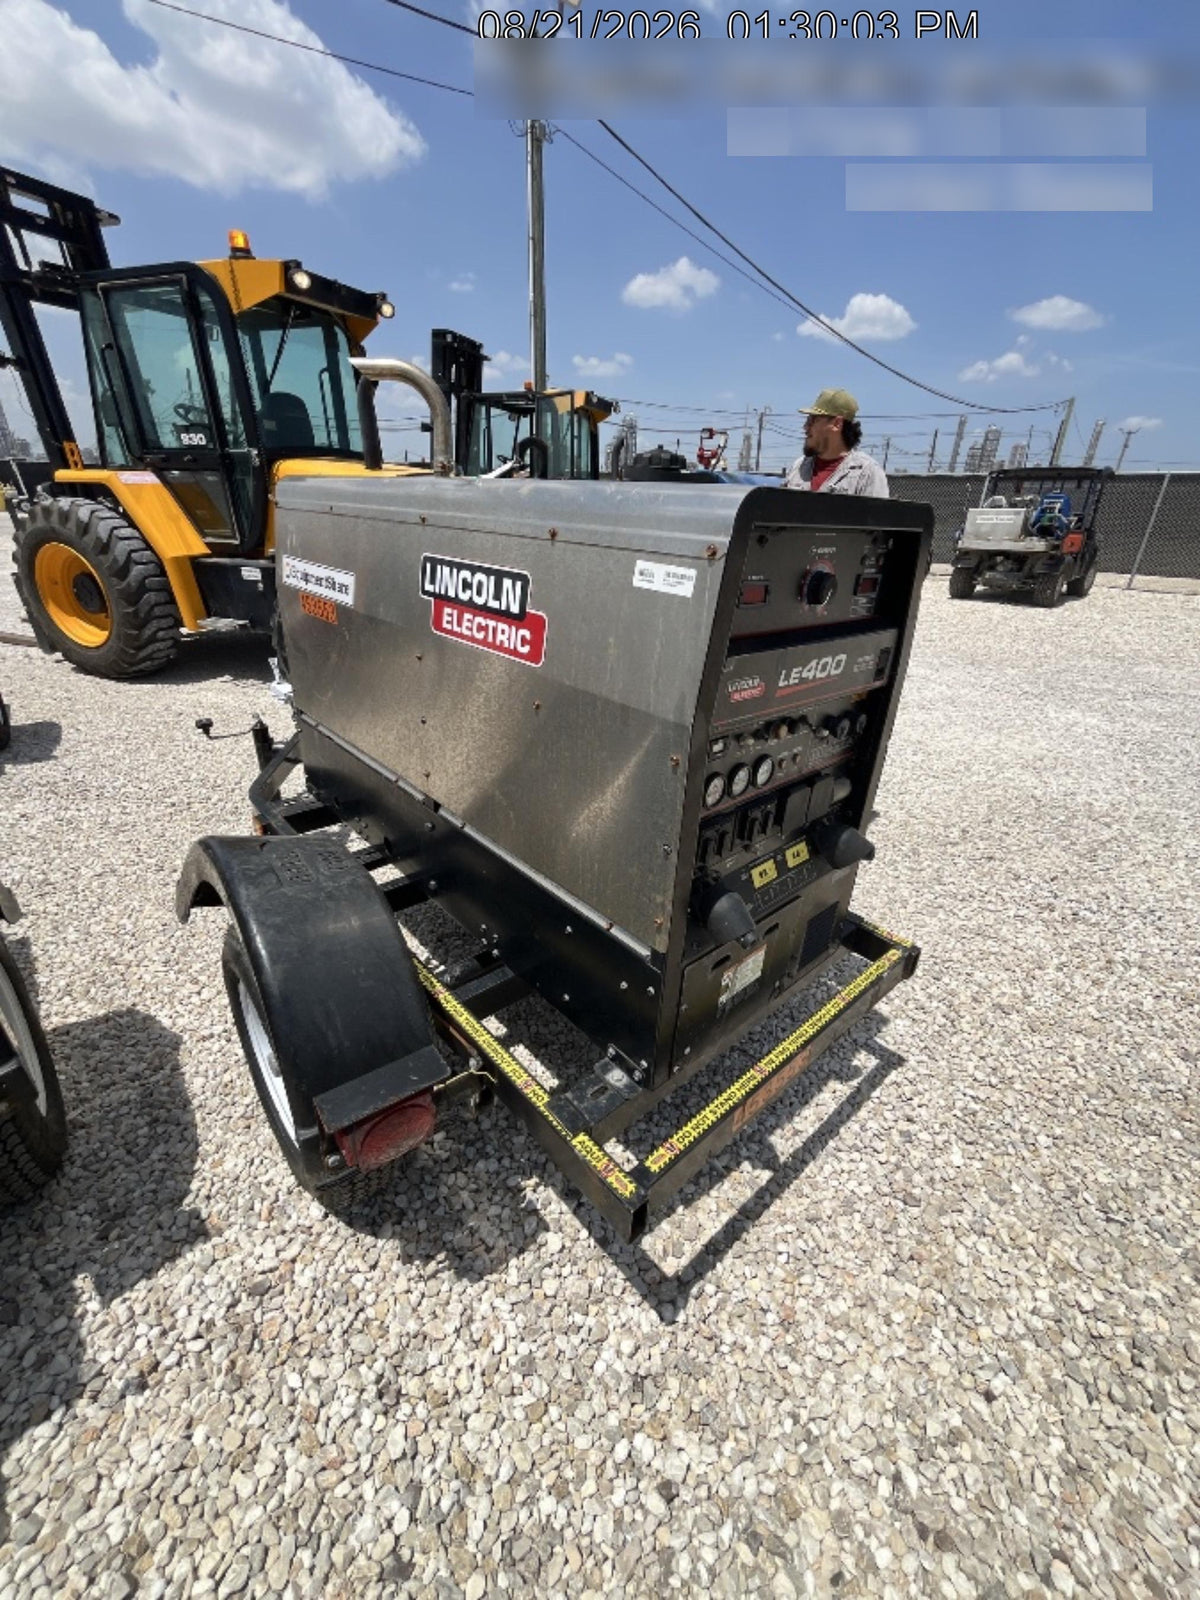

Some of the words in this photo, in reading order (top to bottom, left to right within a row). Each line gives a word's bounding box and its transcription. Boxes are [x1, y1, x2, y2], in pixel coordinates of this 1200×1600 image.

[180, 433, 207, 445] 930
[424, 562, 522, 614] LINCOLN
[442, 606, 531, 654] ELECTRIC
[778, 653, 847, 687] LE400
[675, 1129, 691, 1145] DO
[709, 1089, 738, 1116] STAND
